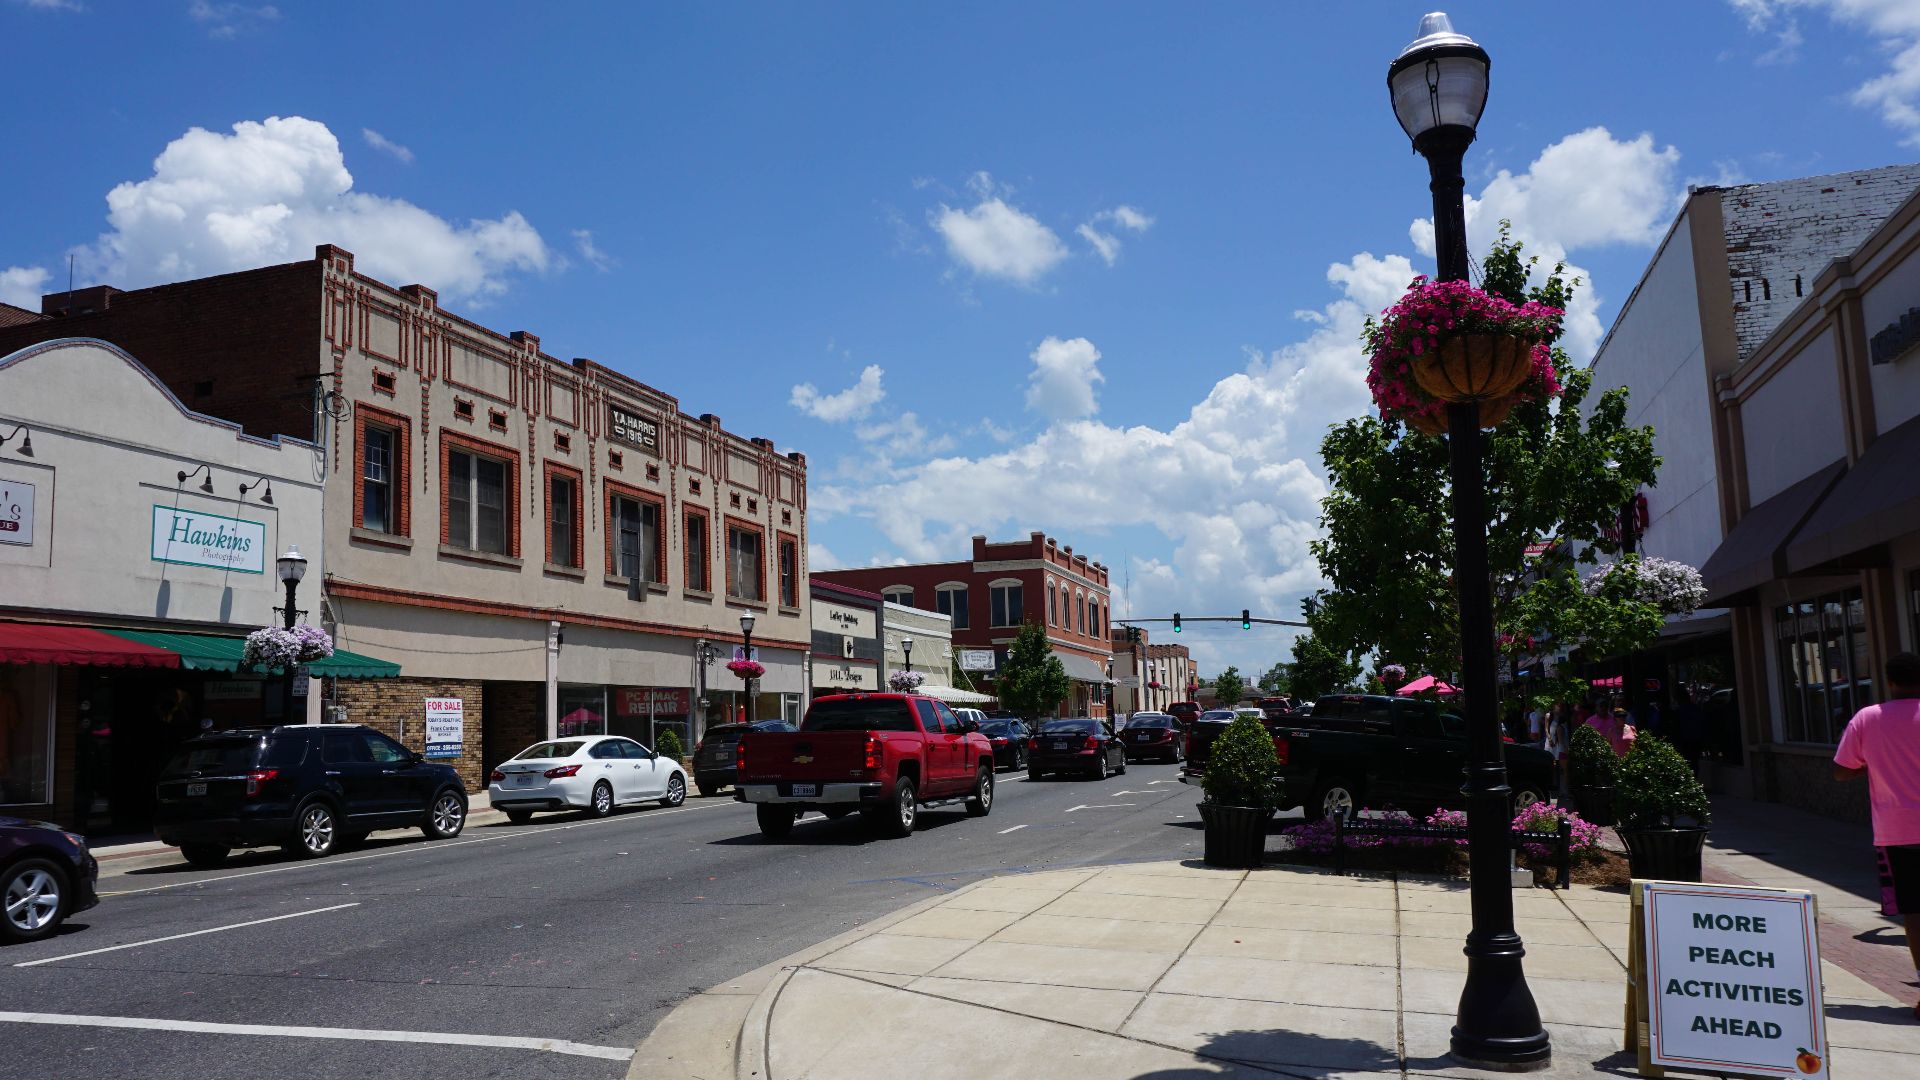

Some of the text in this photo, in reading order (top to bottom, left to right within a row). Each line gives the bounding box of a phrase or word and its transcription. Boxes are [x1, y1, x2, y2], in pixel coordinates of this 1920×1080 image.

[627, 416, 656, 436] HARRIS
[168, 516, 251, 552] Hawkins
[202, 548, 246, 565] Photography
[427, 702, 461, 710] FOR SALE
[626, 691, 641, 702] PC
[653, 691, 680, 702] MAC
[629, 702, 678, 713] REPAIR
[1692, 912, 1767, 934] MORE
[1689, 945, 1775, 969] PEACH
[1665, 978, 1804, 1007] ACTIVITIES
[1690, 1015, 1782, 1040] AHEAD
